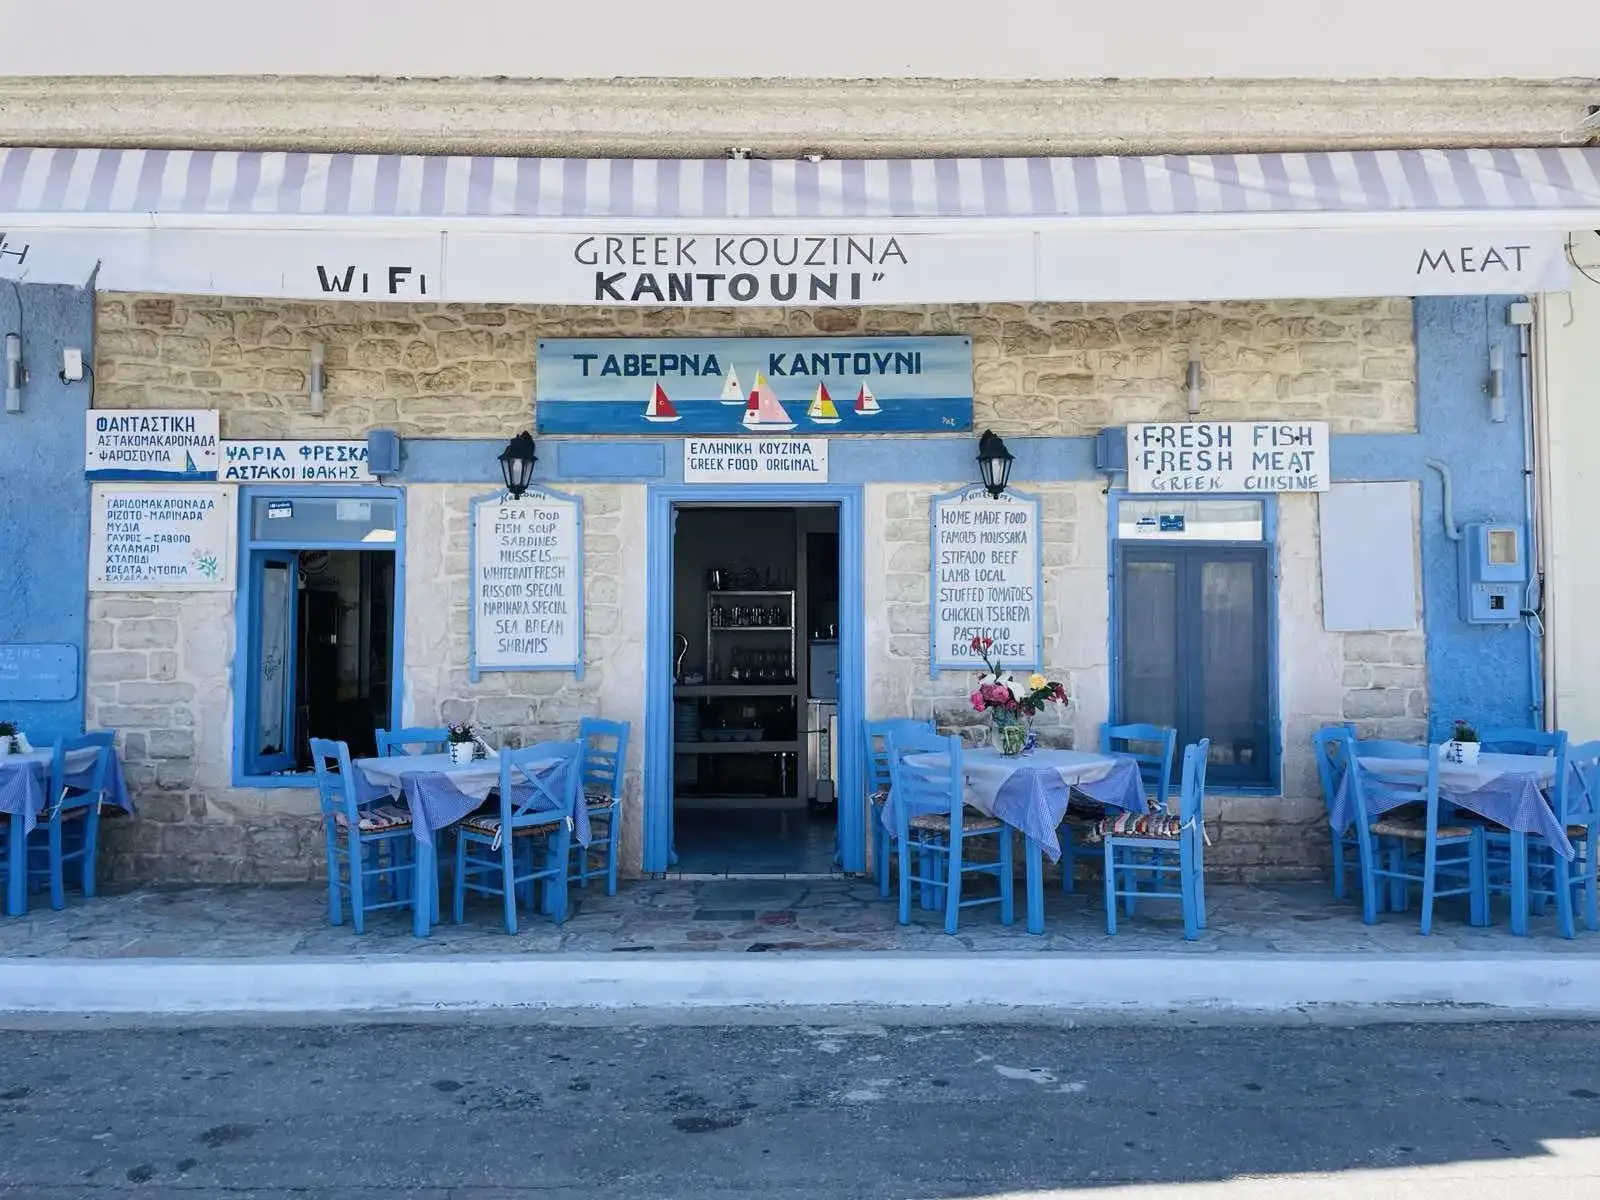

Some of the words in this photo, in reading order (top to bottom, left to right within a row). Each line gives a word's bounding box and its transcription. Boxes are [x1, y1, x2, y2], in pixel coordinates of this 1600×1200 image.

[574, 236, 697, 266] GREEK
[715, 236, 908, 266] KOUZINA
[1416, 245, 1531, 275] MEAT
[573, 353, 722, 377] ΤΑΒΕΡΝΑ
[768, 351, 922, 376] ΚΑΝΤΟΥΝΙ
[96, 416, 195, 432] ΦΑΝΤΑΣΤΙΚΗ
[98, 435, 216, 447] ΑΣΤΑΚΟΜΑΚΑΡΟΝΑΔΑ
[1143, 425, 1232, 448] FRESH
[1252, 425, 1312, 447] FISH
[99, 450, 171, 462] ΨΑΡΟΣΟΥΠΑ
[225, 446, 286, 461] ΨΑΡΙΑ
[690, 442, 752, 455] ΕΛΛΗΝΙΚΗ
[759, 442, 812, 455] ΚΟΥΖΙΝΑ
[690, 458, 724, 471] GREEK
[728, 458, 758, 471] FOOD
[766, 458, 819, 472] ORIGINAL
[1143, 450, 1233, 472] FRESH
[1252, 451, 1315, 472] MEAT
[225, 465, 295, 480] ΑΣΤΑΚΟΙ
[302, 466, 360, 480] ΙΘΑΚΗΣ
[1151, 477, 1223, 490] GREEK
[1244, 474, 1319, 490] CUISINE
[498, 508, 526, 520] SEA
[533, 509, 560, 520] FOOD
[941, 508, 971, 525] HOME
[973, 510, 1001, 525] MADE
[1004, 511, 1027, 524] FOOD
[107, 522, 140, 532] ΜΥΔΙΑ
[495, 523, 520, 534] FISH
[528, 523, 556, 534] SOUP
[501, 535, 557, 547] SARDINES
[941, 530, 976, 544] FAMOUS
[980, 530, 1027, 544] MOUSSAKA
[106, 544, 160, 553] ΚΑΛΑΜΑΡΙ
[105, 555, 149, 564] ΧΤΑΠΟΔΙ
[941, 550, 986, 565] STIFADO
[991, 550, 1018, 565] BEEF
[148, 565, 188, 575] ΝΤΟΠΙΑ
[942, 568, 970, 582] LAMB
[975, 568, 1006, 581] LOCAL
[482, 584, 522, 598] RISSOTO
[525, 583, 566, 597] SPECIAL
[940, 587, 984, 602] STUFFED
[987, 586, 1033, 602] TOMATOES
[483, 601, 530, 616] MARINARA
[532, 600, 568, 615] SPECIAL
[941, 606, 983, 622] CHICKEN
[986, 605, 1030, 622] TSEREPA
[496, 619, 518, 634] SEA
[953, 626, 1010, 641] PASTICCIO
